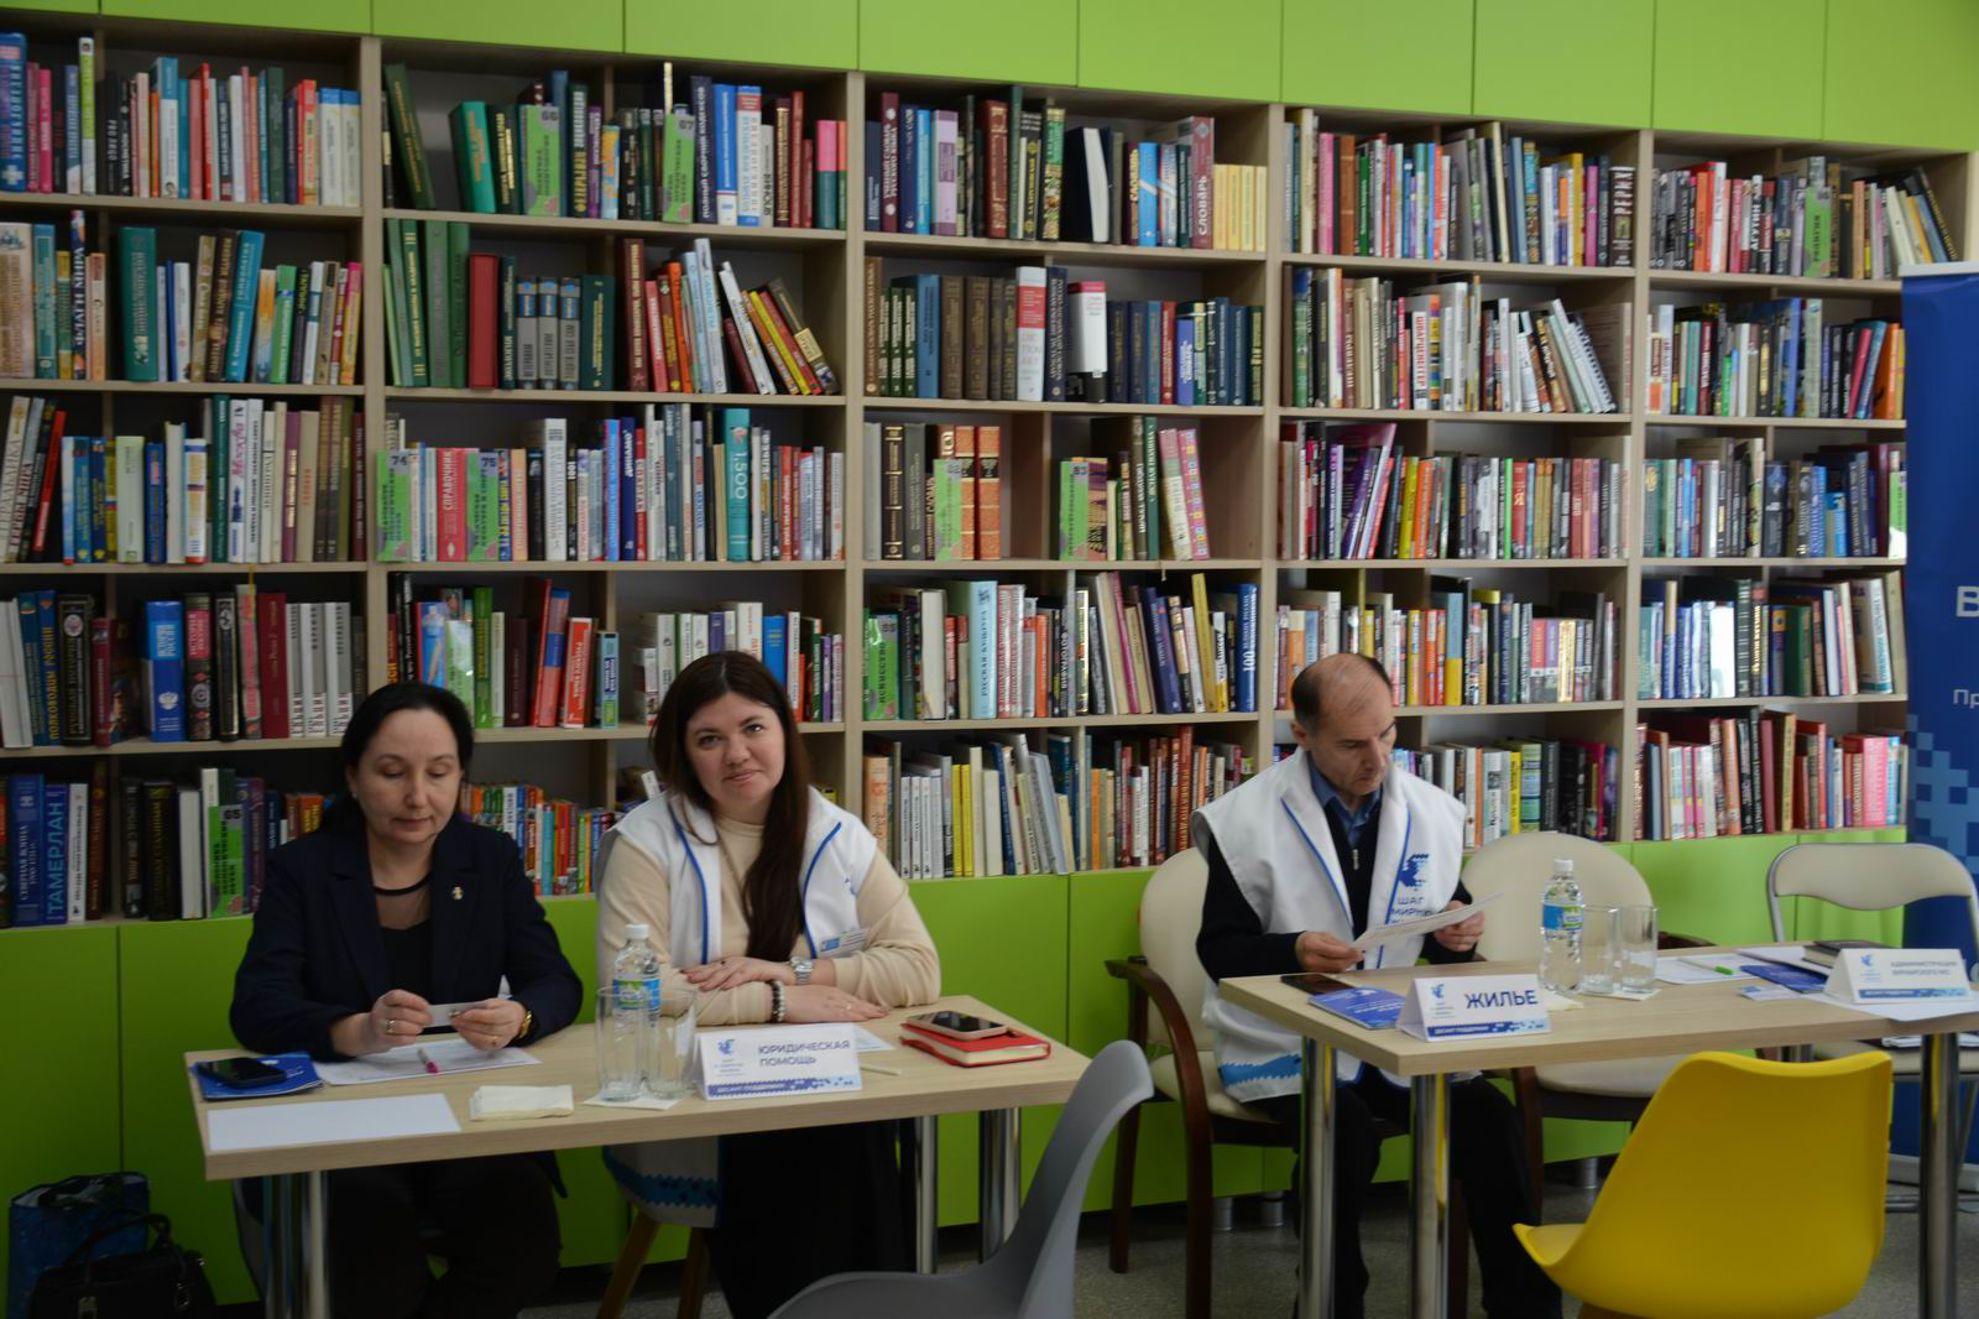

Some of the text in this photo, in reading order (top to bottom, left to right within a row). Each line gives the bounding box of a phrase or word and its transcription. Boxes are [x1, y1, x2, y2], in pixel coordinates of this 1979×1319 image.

[697, 86, 711, 219] ПОЛНЫЙ СБОРНИК КОДЕКСОВ
[1197, 175, 1209, 235] СЛОВАРЬ
[1613, 171, 1634, 215] РЕРИХ
[74, 247, 86, 346] ФЛАГИ МИРА
[1415, 316, 1427, 387] ШВАРЦЕНЕГГЕР
[391, 455, 409, 466] 74
[481, 456, 497, 467] 75
[567, 461, 576, 480] 1001
[623, 432, 634, 477] ДИНАМО
[733, 451, 748, 499] 1,500
[443, 451, 453, 511] СПРАВОЧНИК
[878, 642, 887, 704] ИСКУССТВО
[1061, 631, 1069, 689] ФОТОГРАФИЯ
[1243, 651, 1255, 672] 100
[223, 808, 241, 820] 65
[47, 802, 65, 913] ТАМЕРЛАН
[1465, 989, 1539, 1009] ЖИЛЬЕ
[758, 1039, 851, 1055] ЮРИДИЧЕСКАЯ
[759, 1055, 817, 1068] ПОМОЩЬ
